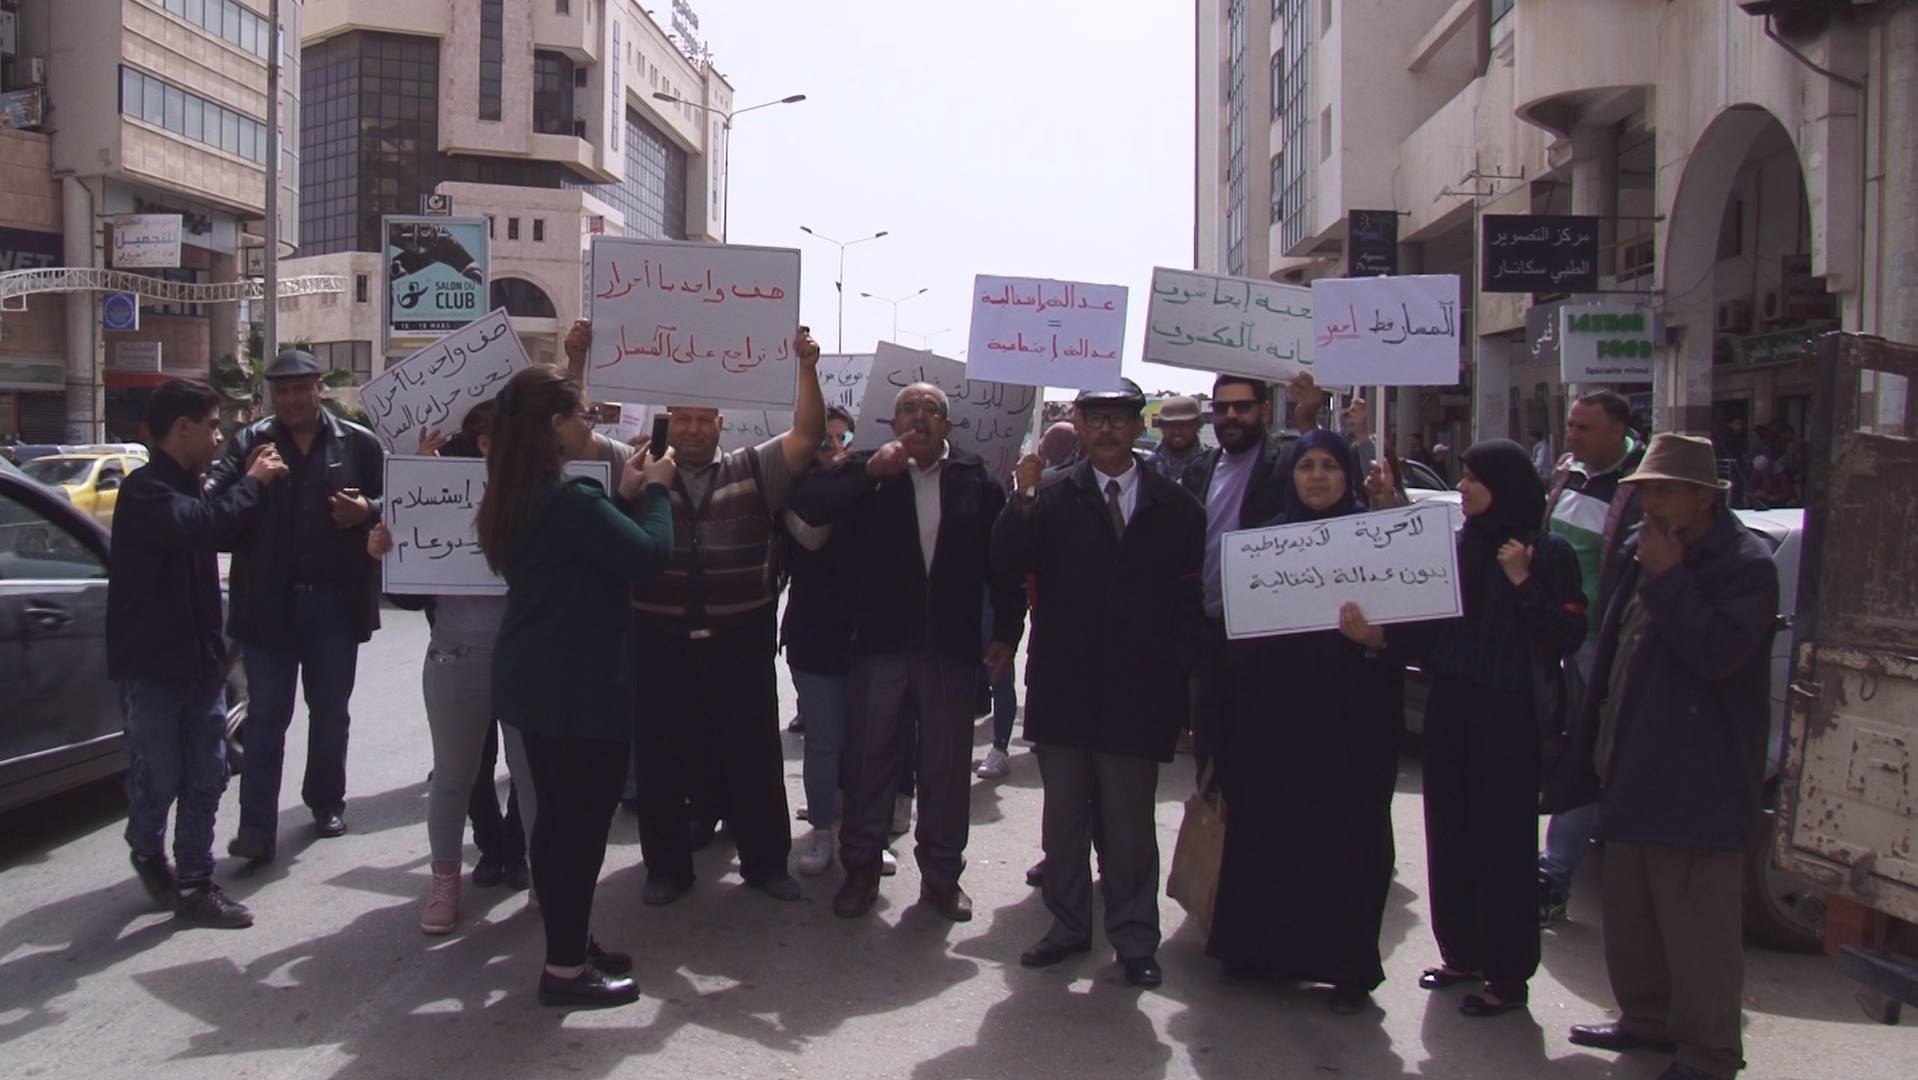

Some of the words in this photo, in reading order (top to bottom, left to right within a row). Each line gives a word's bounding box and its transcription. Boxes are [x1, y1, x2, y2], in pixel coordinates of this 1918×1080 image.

[1492, 226, 1549, 247] التصوير
[1554, 227, 1591, 246] مركز
[1493, 259, 1547, 278] سكانار
[1551, 259, 1589, 283] الطبي
[435, 281, 463, 291] SALON
[464, 281, 475, 291] DU
[435, 292, 475, 310] CLUB
[467, 322, 508, 354] صف
[671, 334, 716, 365] على
[427, 344, 467, 379] واحد
[467, 358, 514, 397] نحن
[1354, 520, 1409, 549] حرية
[1333, 565, 1394, 584] عدالة
